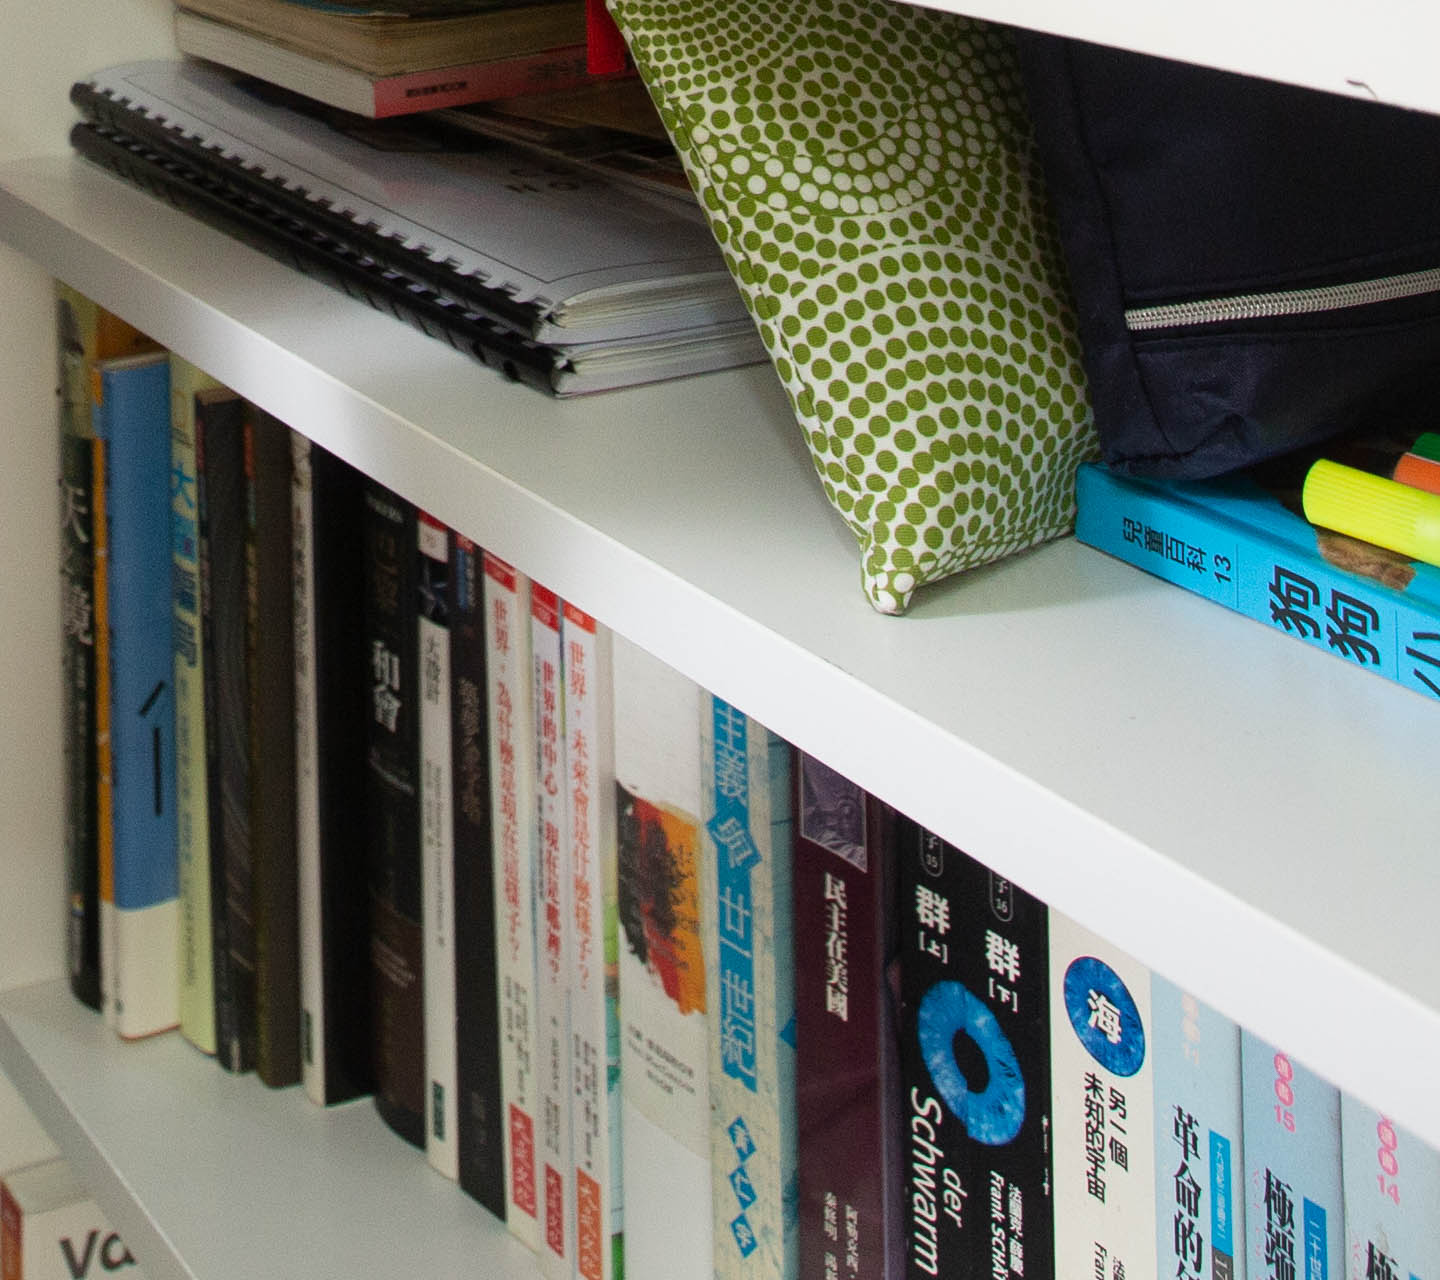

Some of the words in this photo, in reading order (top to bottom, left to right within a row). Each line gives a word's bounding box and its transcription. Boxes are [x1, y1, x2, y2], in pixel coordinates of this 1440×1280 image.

[1121, 516, 1209, 576] 兒童百科
[1213, 551, 1234, 585] 13
[1268, 564, 1381, 667] 狗狗
[915, 884, 951, 935] 群
[985, 928, 1021, 983] 群
[1087, 989, 1122, 1045] 海
[1083, 1072, 1107, 1205] 未知的宇宙
[1108, 1085, 1129, 1172] 另一個
[1273, 1107, 1296, 1133] 15
[909, 1088, 943, 1277] Schwarm
[941, 1167, 969, 1228] der
[989, 1169, 1006, 1222] Frank
[1377, 1174, 1401, 1206] 14
